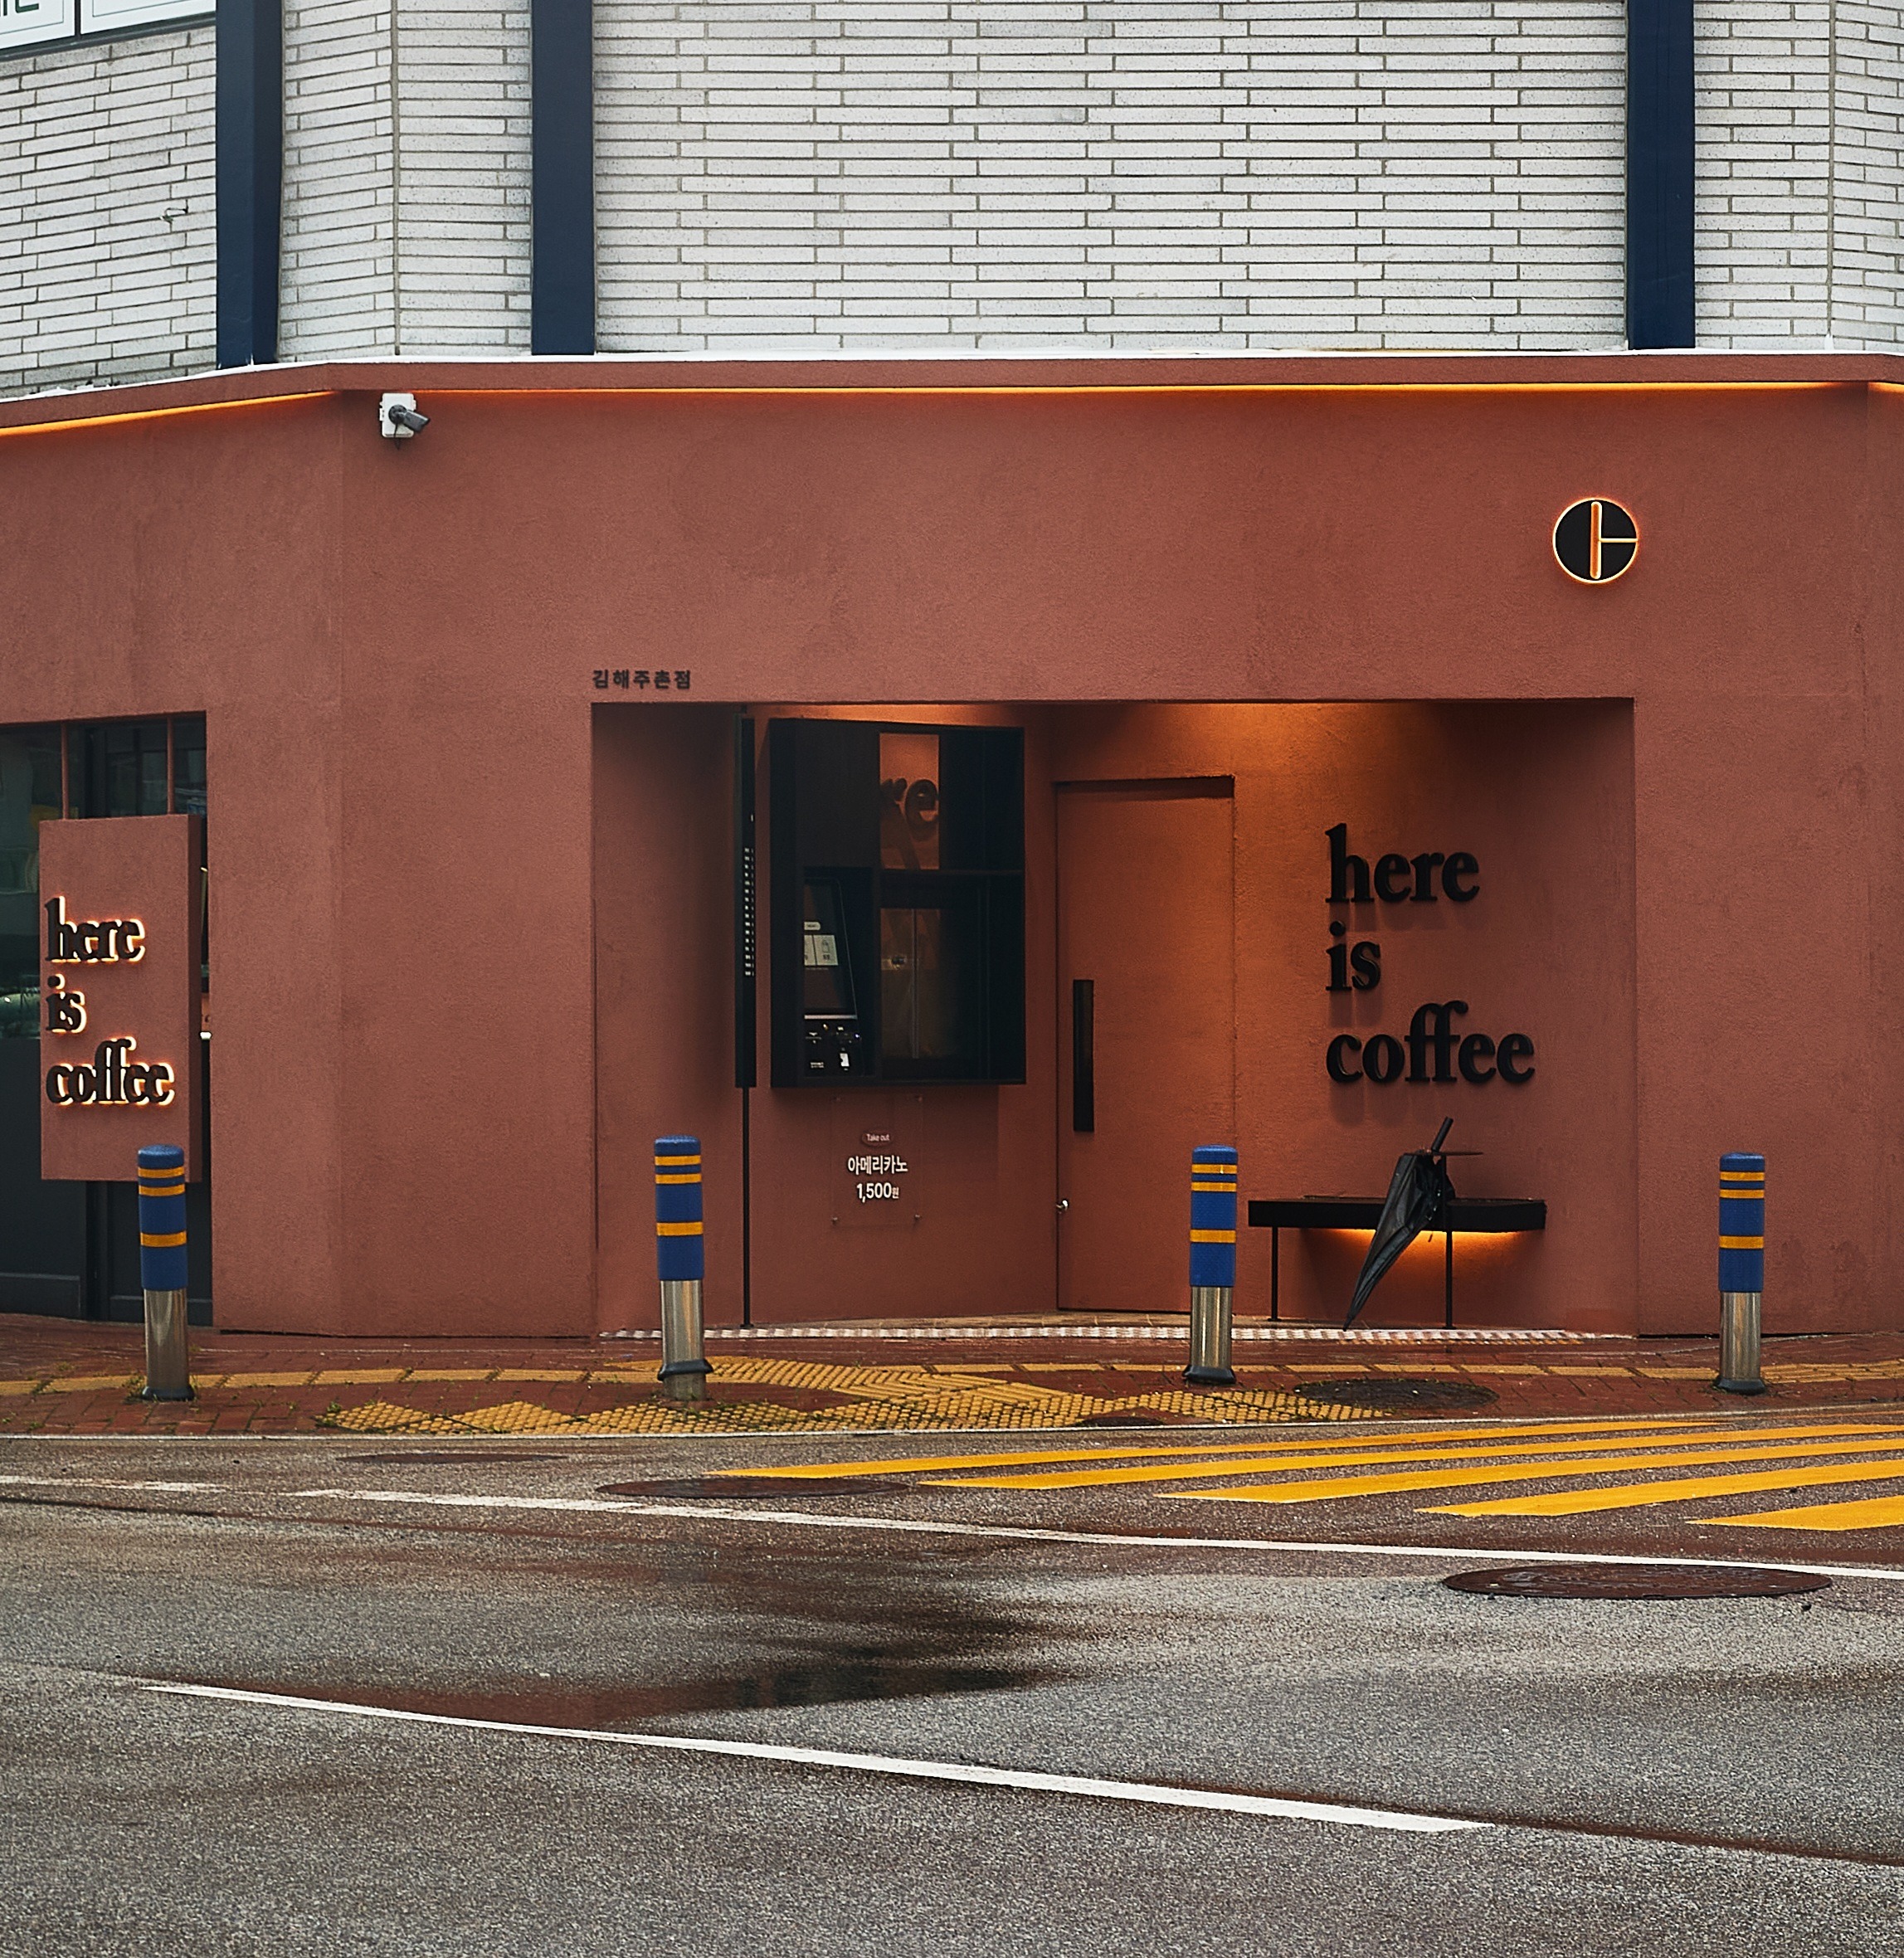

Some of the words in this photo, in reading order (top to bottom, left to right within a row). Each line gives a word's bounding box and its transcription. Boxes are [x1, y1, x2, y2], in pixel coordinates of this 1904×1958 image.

[592, 669, 691, 689] 김해주촌점
[1325, 822, 1480, 903] here
[44, 896, 145, 962] here
[1326, 920, 1381, 991] is
[46, 974, 87, 1033] is
[46, 1037, 175, 1106] coffee
[1326, 1000, 1535, 1084] coffee
[848, 1155, 908, 1175] 아메리카노
[867, 1133, 879, 1142] Take
[856, 1182, 899, 1203] 1,500원
